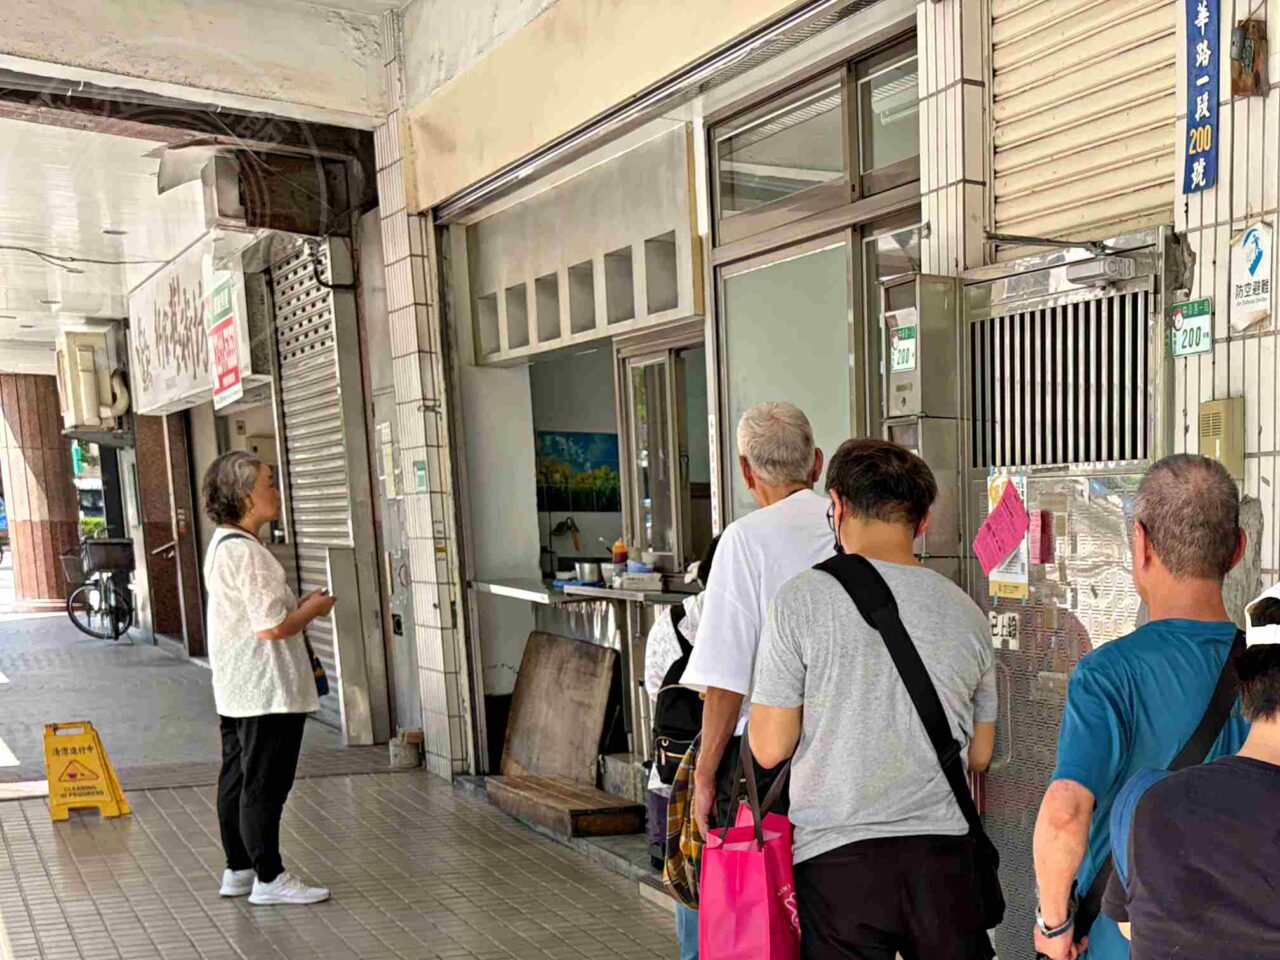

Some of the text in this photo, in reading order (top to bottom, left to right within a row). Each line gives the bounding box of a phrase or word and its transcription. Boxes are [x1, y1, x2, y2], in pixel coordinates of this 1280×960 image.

[1235, 279, 1270, 299] 防空避難
[1181, 326, 1201, 349] 200
[896, 347, 910, 366] 200
